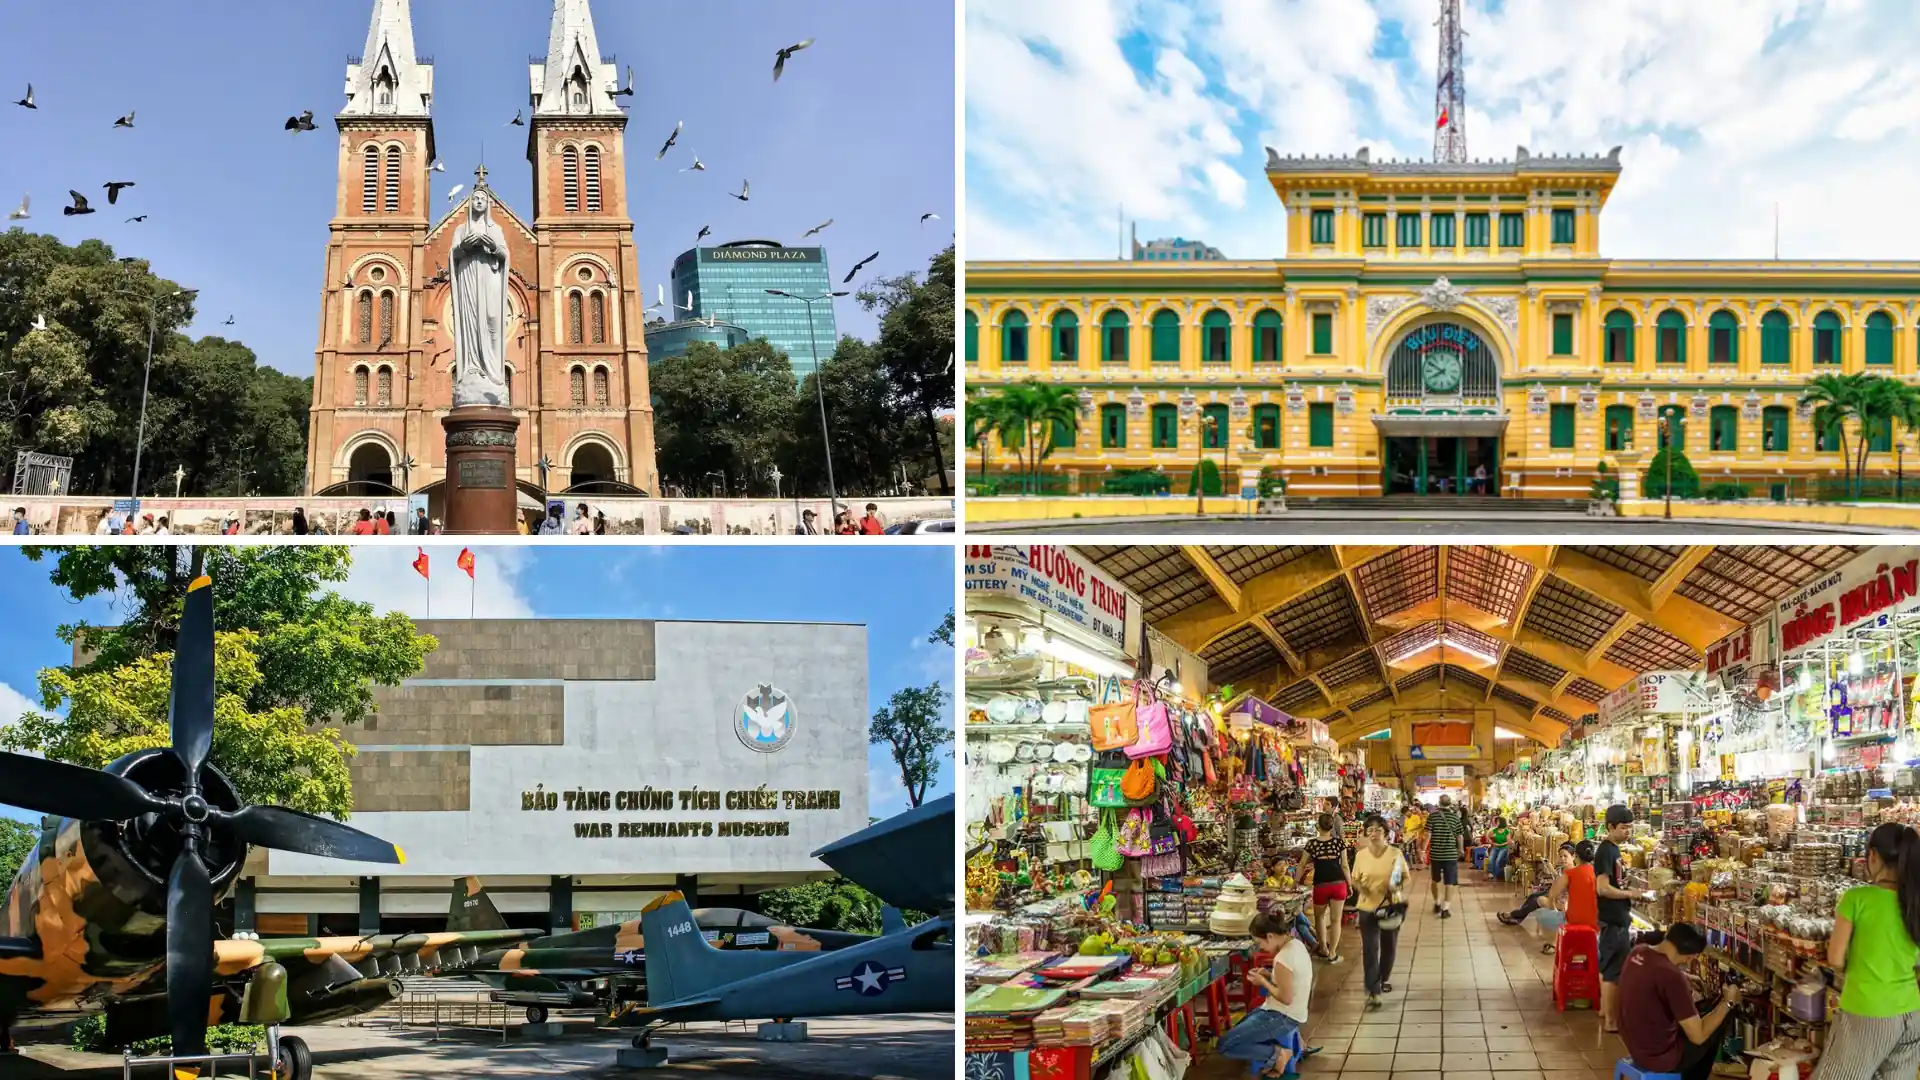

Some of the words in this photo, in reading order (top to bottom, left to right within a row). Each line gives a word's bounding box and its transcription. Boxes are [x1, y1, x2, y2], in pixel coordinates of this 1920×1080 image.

[712, 251, 767, 259] DIAMOND
[770, 251, 806, 259] PLAZA
[1021, 584, 1037, 601] FINE
[1038, 594, 1053, 608] ARTS
[521, 783, 558, 811] BẢO
[563, 786, 611, 811] TÀNG
[615, 784, 674, 811] CHỨNG
[678, 785, 721, 811] TÍCH
[725, 783, 778, 810] CHIẾN
[782, 790, 841, 810] TRANH
[574, 823, 613, 838] WAR
[618, 821, 713, 838] REMNANTS
[717, 821, 790, 837] MUSEUM
[667, 921, 692, 938] 1448
